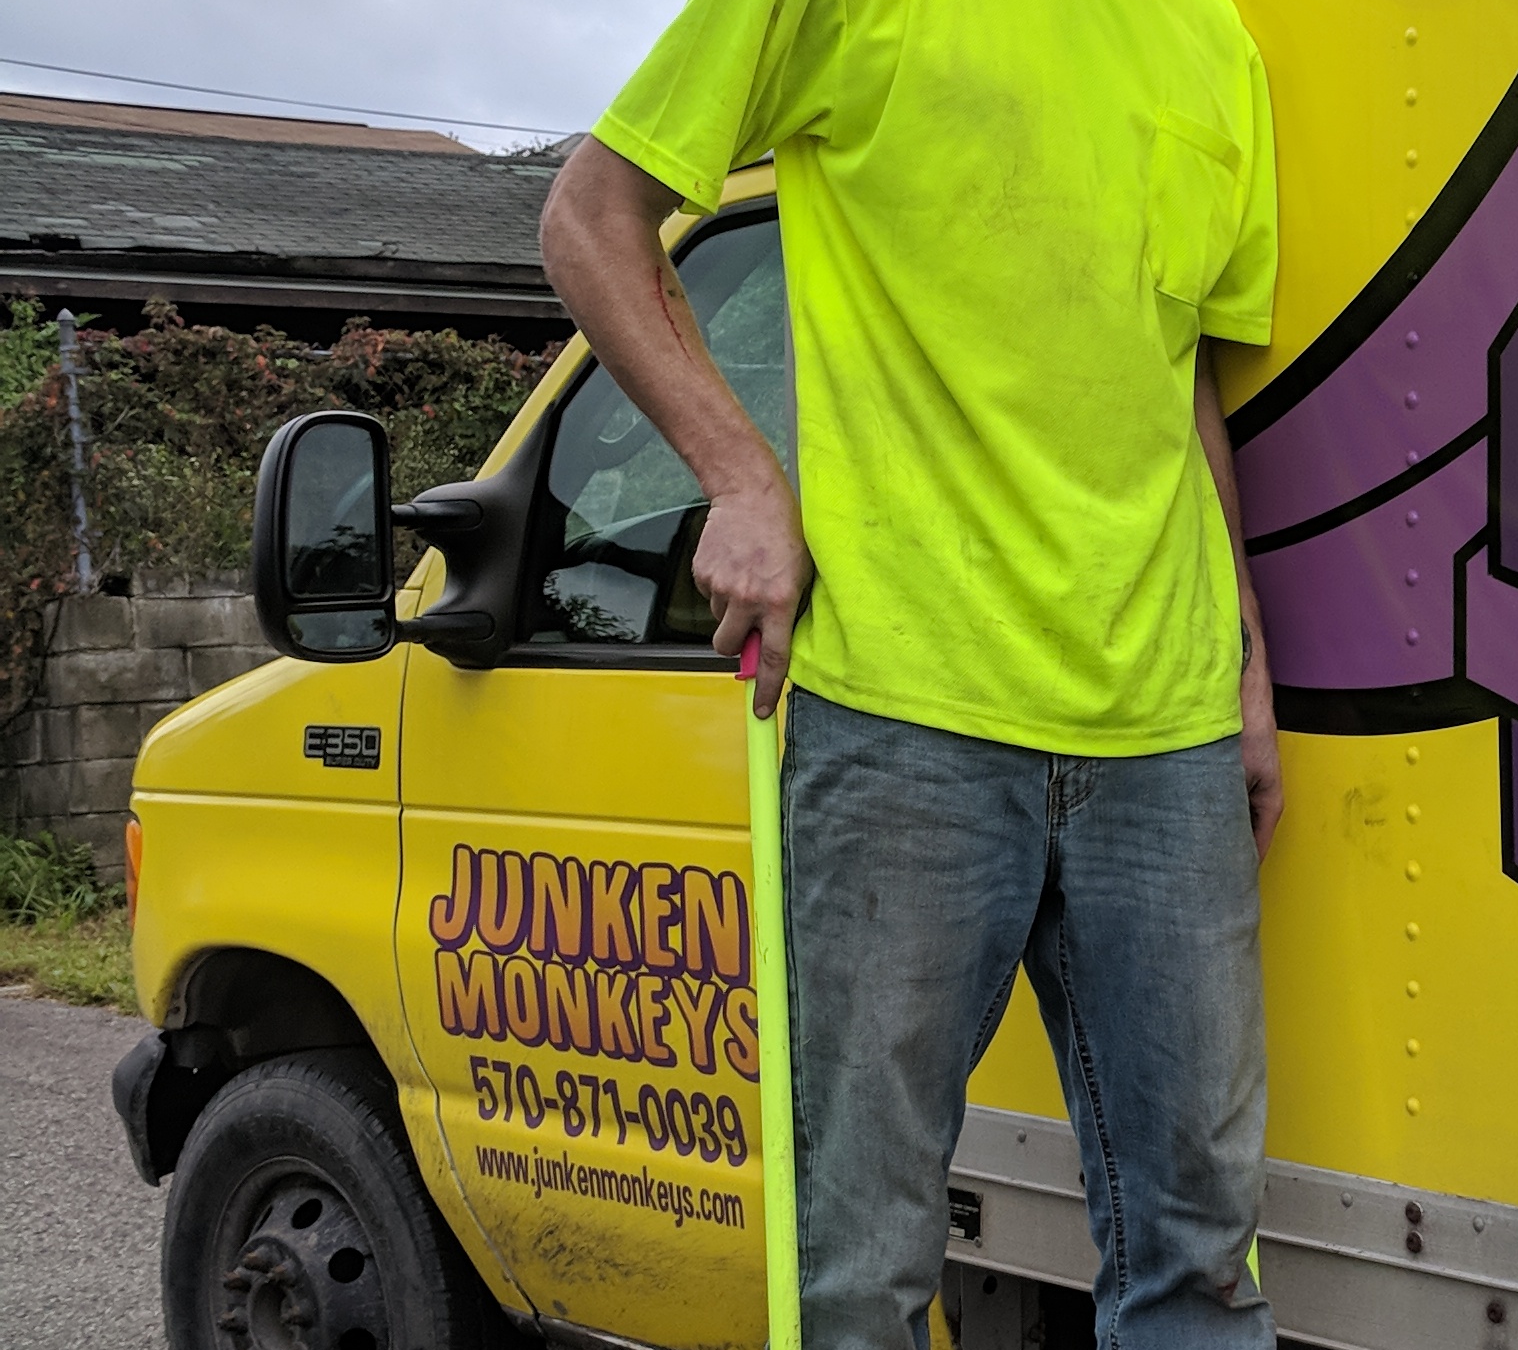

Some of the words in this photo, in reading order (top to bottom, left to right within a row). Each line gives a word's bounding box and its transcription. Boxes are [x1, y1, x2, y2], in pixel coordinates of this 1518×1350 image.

[430, 844, 750, 986] JUNKEN
[435, 949, 760, 1082] MONKEYS
[470, 1055, 748, 1166] 570-871-0039
[476, 1145, 746, 1229] www.junkenmonkeys.com
